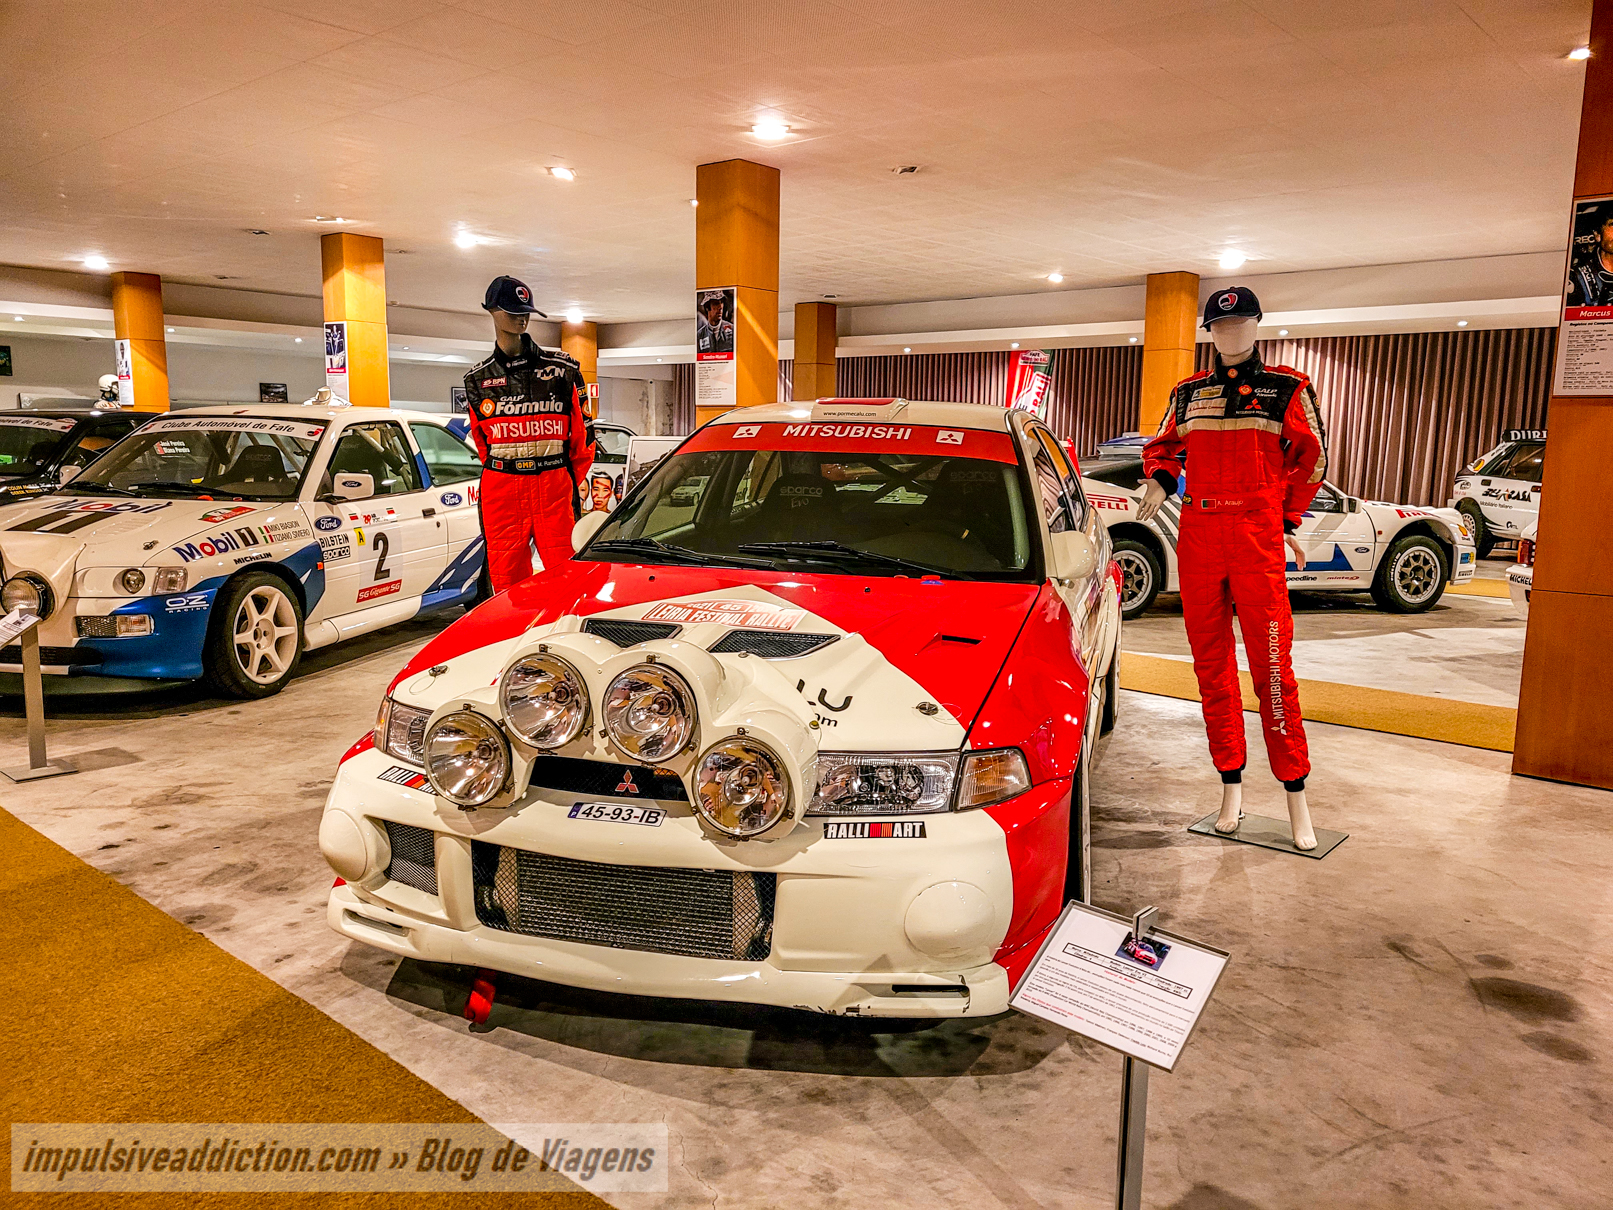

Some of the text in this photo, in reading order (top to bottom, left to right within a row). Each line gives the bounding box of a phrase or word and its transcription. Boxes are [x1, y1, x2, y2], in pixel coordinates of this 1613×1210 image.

[534, 365, 565, 380] TMN
[193, 420, 252, 429] Automóvel
[269, 423, 295, 433] Fafe
[490, 420, 563, 438] MITSUBISHI
[782, 424, 912, 440] MITSUBISHI
[780, 486, 823, 497] sparco
[40, 499, 173, 513] Mobil
[444, 494, 460, 505] Ford
[320, 518, 338, 530] Ford
[319, 533, 350, 549] BILSTEIN
[358, 531, 364, 543] A
[172, 531, 240, 563] Mobil
[323, 547, 350, 560] sparco
[234, 552, 272, 565] MICHELIN
[373, 532, 390, 581] 2
[1510, 574, 1532, 585] MICHEL
[359, 591, 369, 600] SG
[390, 583, 401, 592] SG
[650, 604, 692, 620] LEIRIA
[1269, 620, 1285, 720] MITSUBISHI MOTORS
[581, 806, 661, 824] 45-93-IB
[827, 822, 923, 838] RALLI ART
